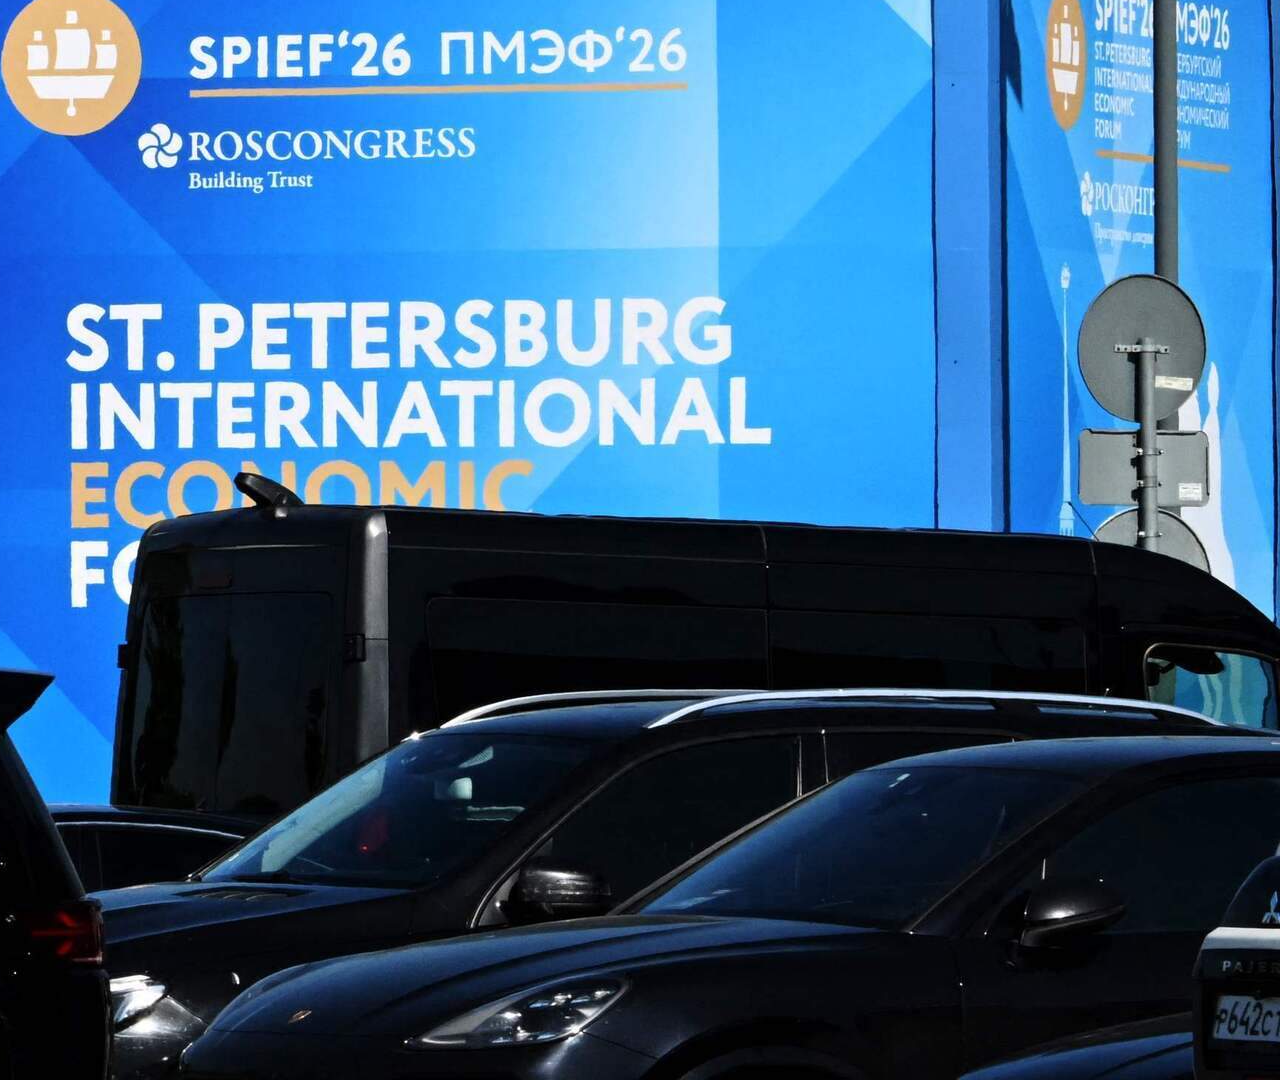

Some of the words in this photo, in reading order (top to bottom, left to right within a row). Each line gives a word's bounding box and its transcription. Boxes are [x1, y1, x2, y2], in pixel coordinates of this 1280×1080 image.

[1176, 0, 1230, 50] МЭФ'26
[1105, 42, 1152, 68] PETERSBURG
[1176, 53, 1222, 78] ЕРБУРГСКИЙ
[1094, 92, 1135, 117] ECONOMIC
[188, 126, 476, 161] ROSCONGRESS
[1094, 118, 1122, 140] FORUM
[188, 171, 264, 193] Building
[267, 171, 313, 188] Trust
[1095, 182, 1155, 216] РОСКОНГР
[66, 304, 175, 371] ST.
[200, 297, 733, 369] PETERSBURG
[71, 377, 772, 450] INTERNATIONAL
